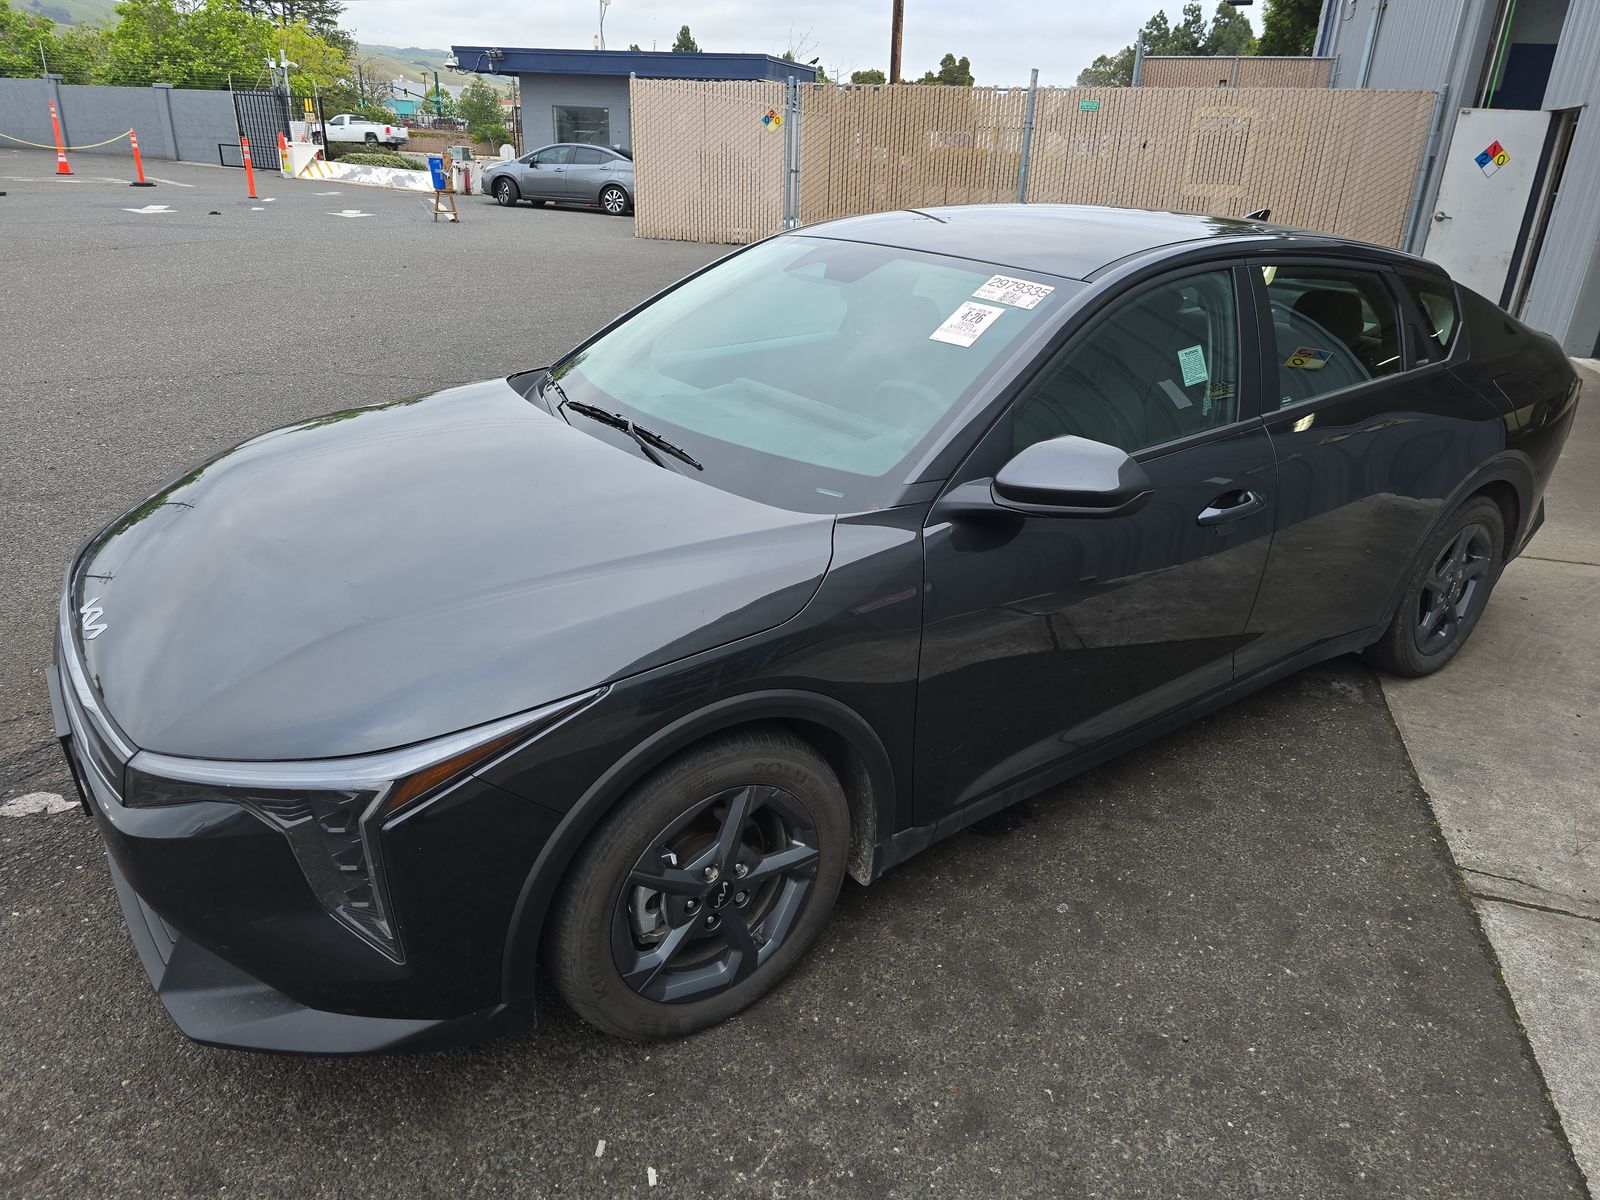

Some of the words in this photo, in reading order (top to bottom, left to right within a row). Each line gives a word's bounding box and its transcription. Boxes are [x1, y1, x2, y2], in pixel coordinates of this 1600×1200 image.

[770, 110, 775, 118] 2
[775, 116, 780, 125] 0
[1480, 153, 1488, 165] 2
[1497, 154, 1505, 166] 0
[988, 277, 1051, 298] 2979335
[961, 311, 986, 324] 4:26
